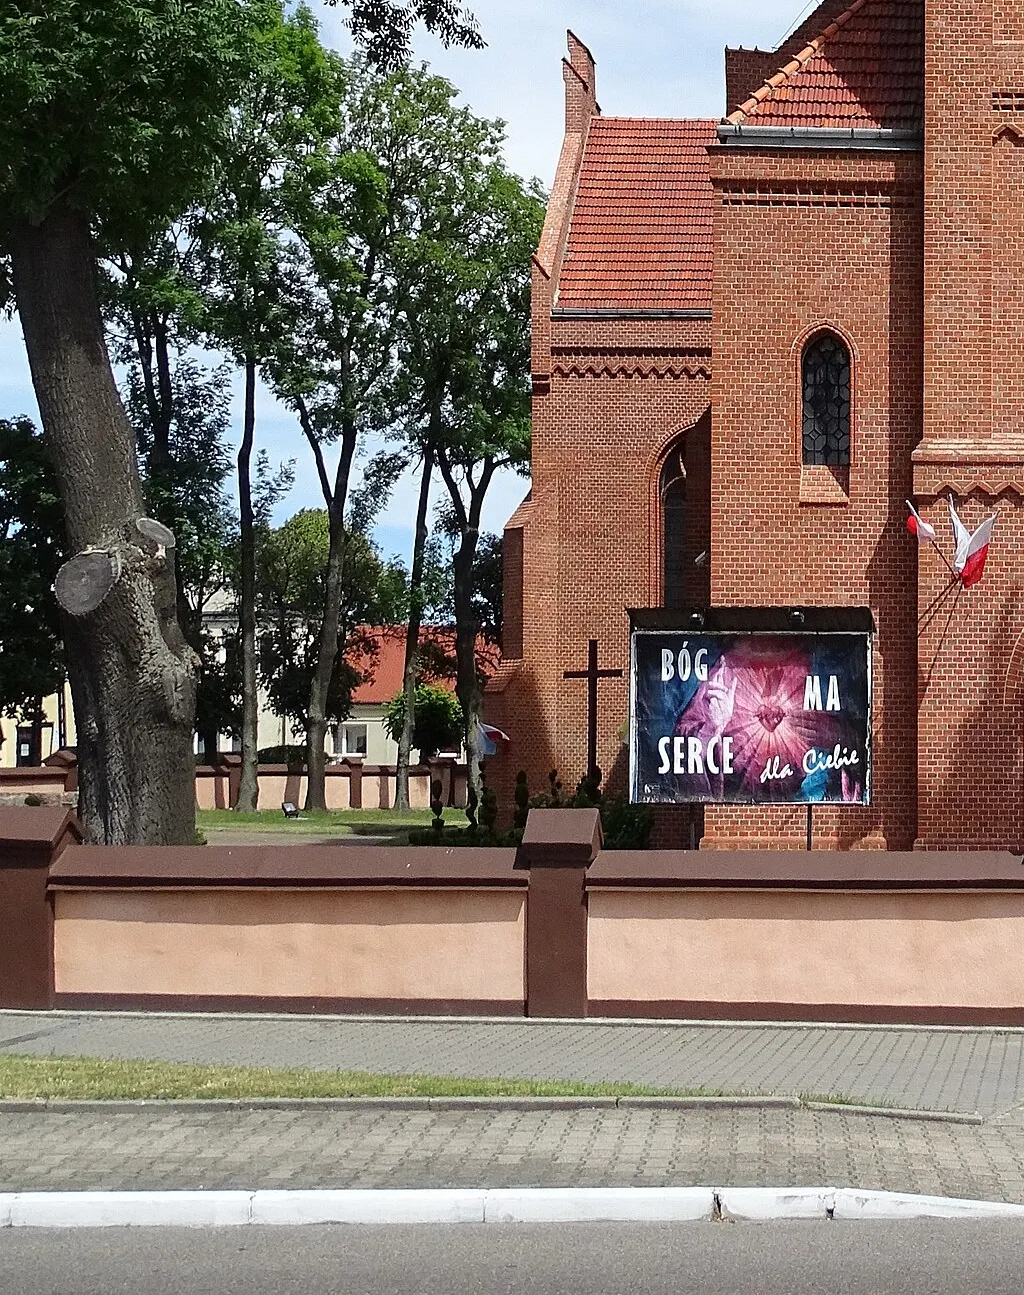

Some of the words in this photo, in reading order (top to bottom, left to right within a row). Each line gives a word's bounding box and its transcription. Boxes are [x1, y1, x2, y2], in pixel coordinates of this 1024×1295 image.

[661, 641, 708, 682] BÓG
[803, 675, 841, 711] MA
[657, 736, 733, 775] SERCE
[760, 759, 793, 784] dla
[802, 744, 859, 775] Ciebie
